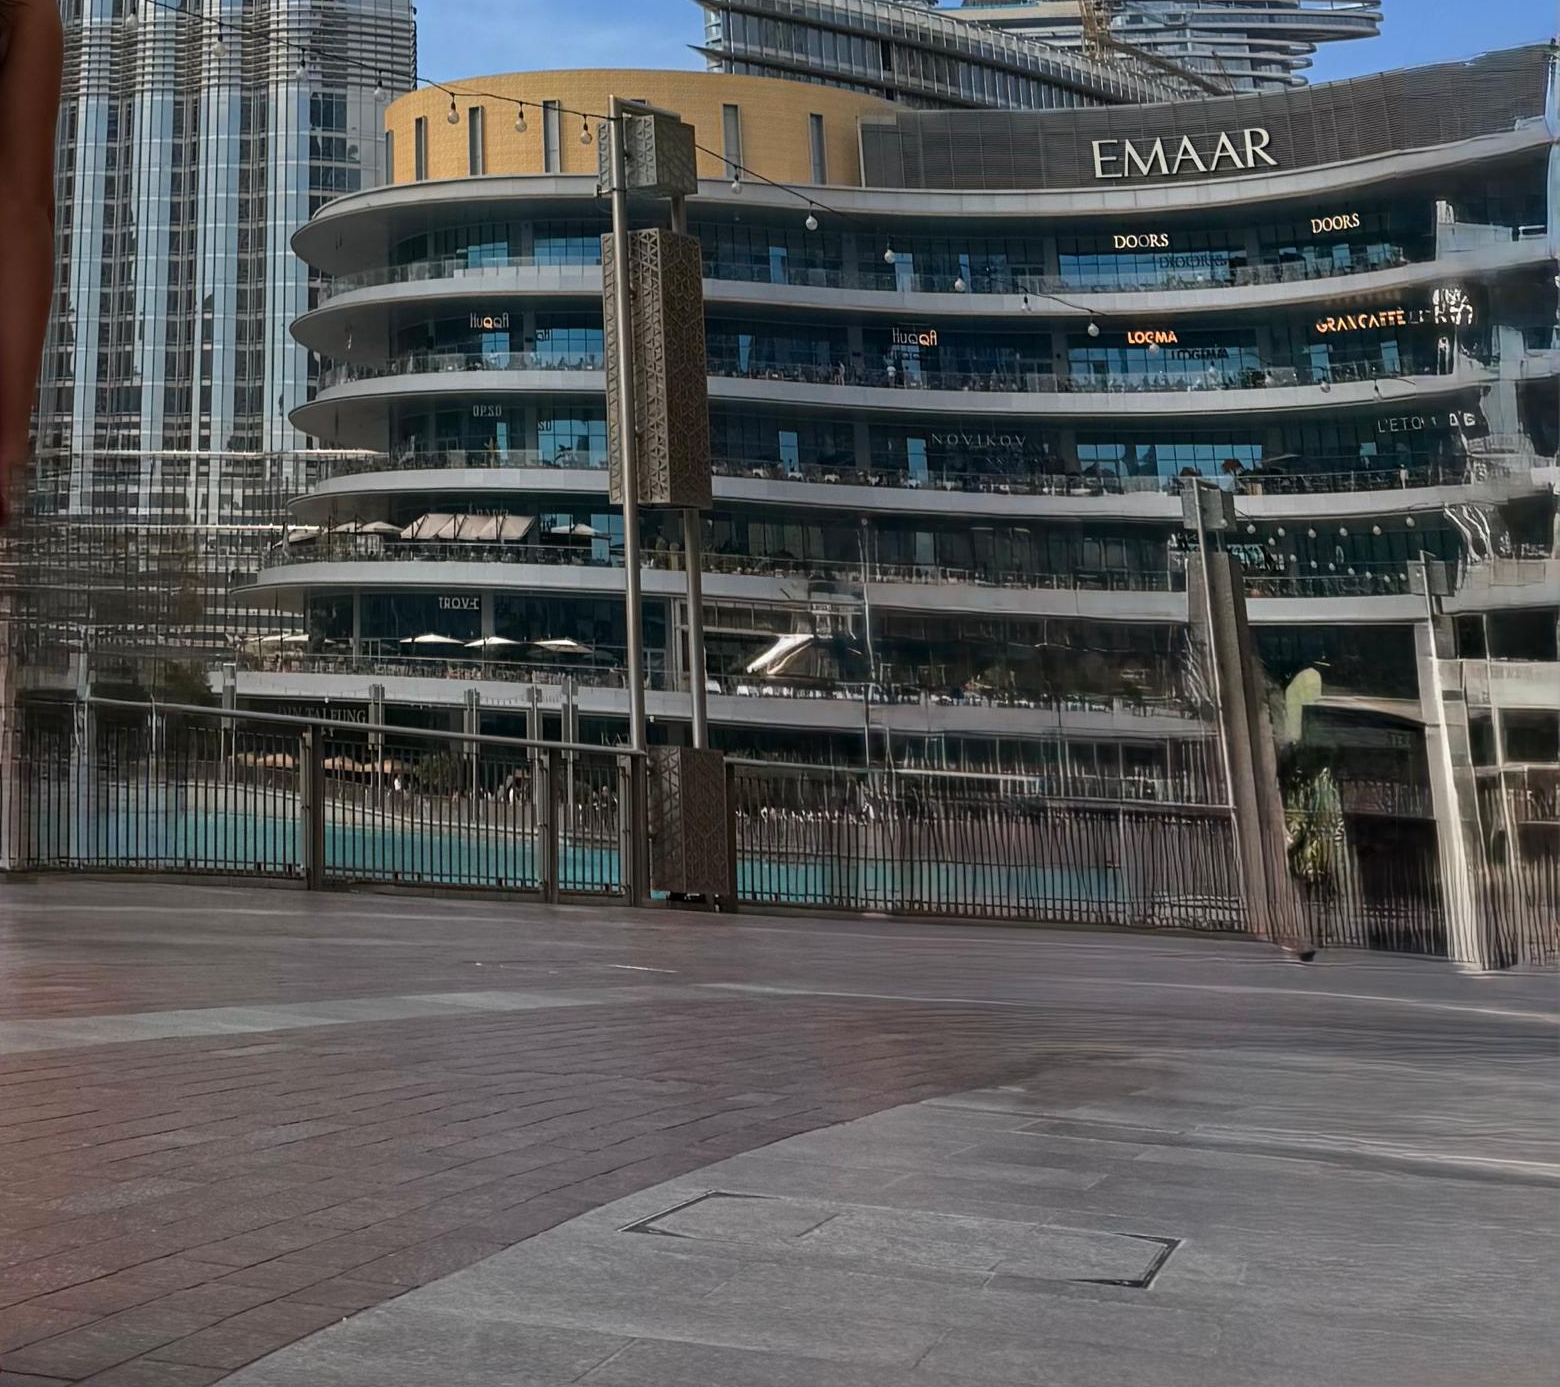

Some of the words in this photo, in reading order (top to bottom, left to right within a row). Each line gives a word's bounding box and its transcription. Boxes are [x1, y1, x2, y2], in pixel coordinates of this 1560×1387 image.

[1091, 127, 1278, 178] EMAAR
[1311, 212, 1361, 234] DOORS
[1113, 233, 1169, 249] DOORS
[931, 432, 1026, 446] NOVIKOV
